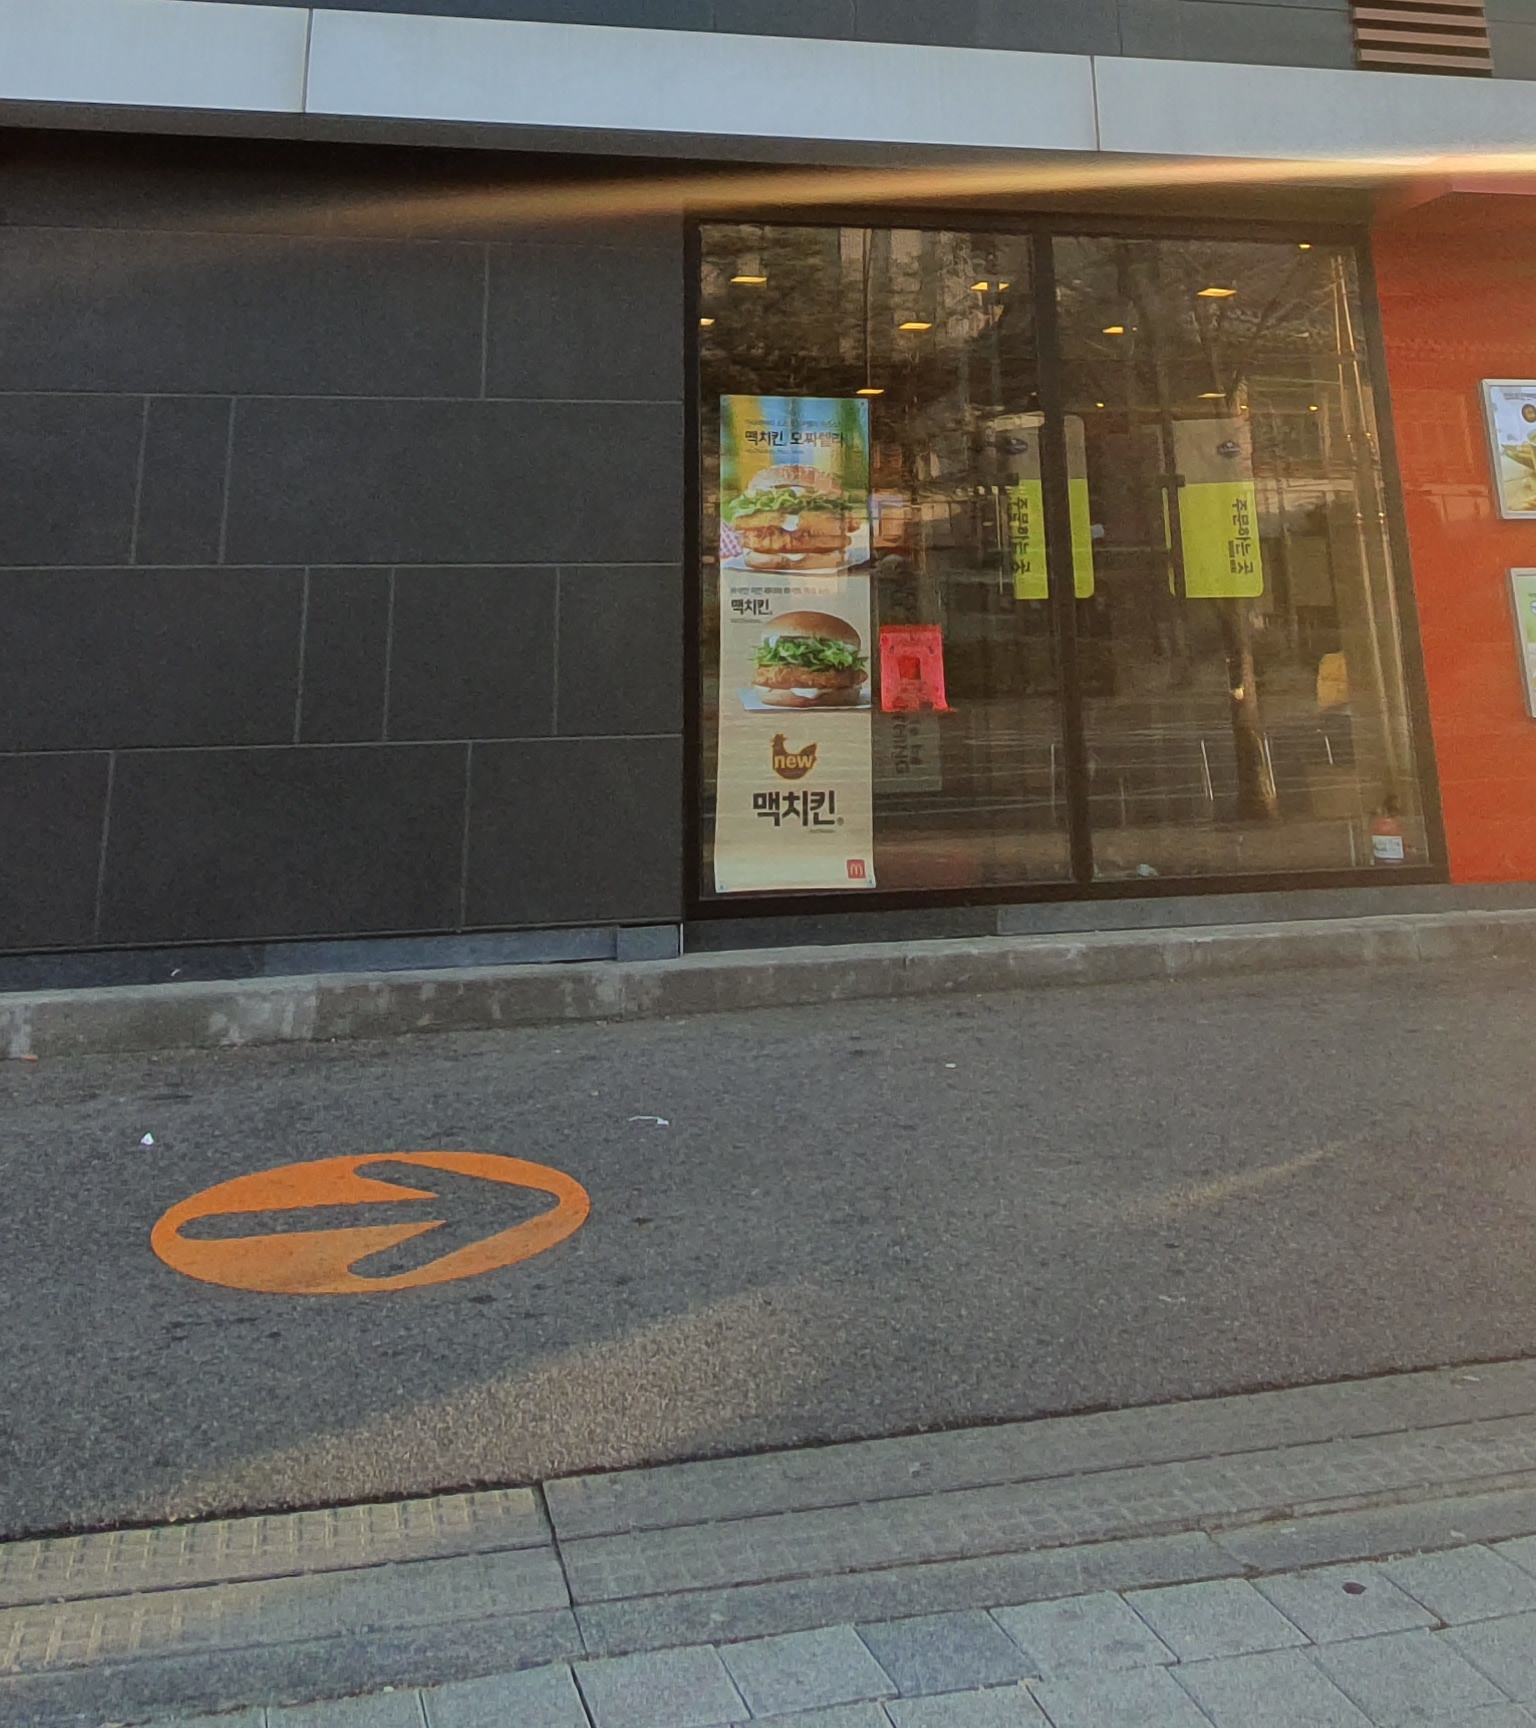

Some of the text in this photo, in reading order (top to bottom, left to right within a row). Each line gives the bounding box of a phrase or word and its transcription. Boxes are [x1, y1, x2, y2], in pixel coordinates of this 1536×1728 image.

[745, 430, 786, 447] 맥치킨
[1231, 498, 1252, 557] 주문하는
[1238, 559, 1254, 575] 곳
[730, 598, 770, 615] 맥치킨
[774, 755, 813, 769] new
[752, 789, 836, 827] 맥치킨
